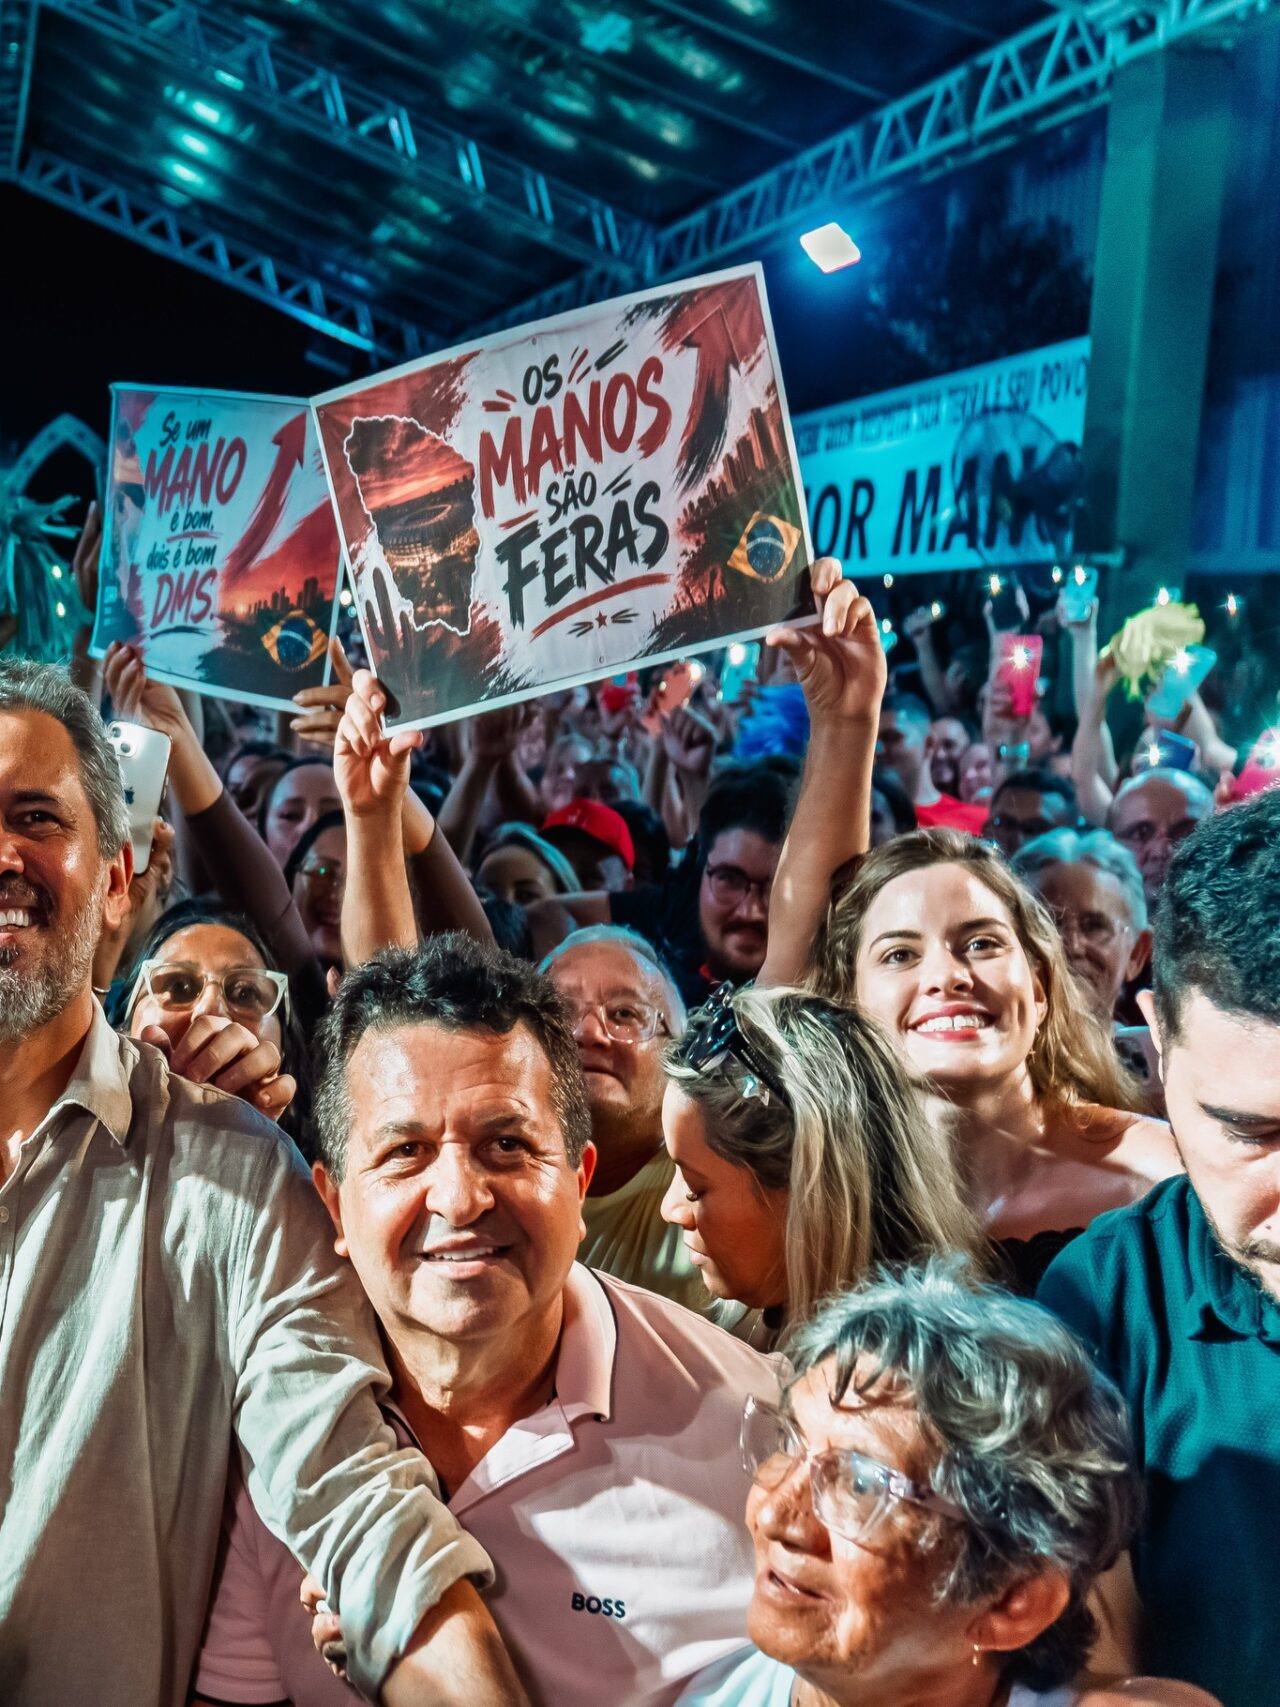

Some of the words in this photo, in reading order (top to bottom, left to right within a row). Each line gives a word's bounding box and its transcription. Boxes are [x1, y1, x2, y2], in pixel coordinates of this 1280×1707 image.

[522, 354, 562, 405] OS
[159, 411, 181, 447] Se
[185, 417, 212, 440] um
[479, 355, 672, 520] MANOS
[144, 437, 247, 520] MANO
[546, 469, 597, 525] SÃO
[170, 505, 180, 533] é
[146, 541, 169, 571] dois
[172, 542, 181, 567] é
[185, 538, 217, 567] bom
[495, 480, 670, 630] FERAS
[149, 569, 217, 630] DMS.
[571, 1592, 626, 1618] BOSS
